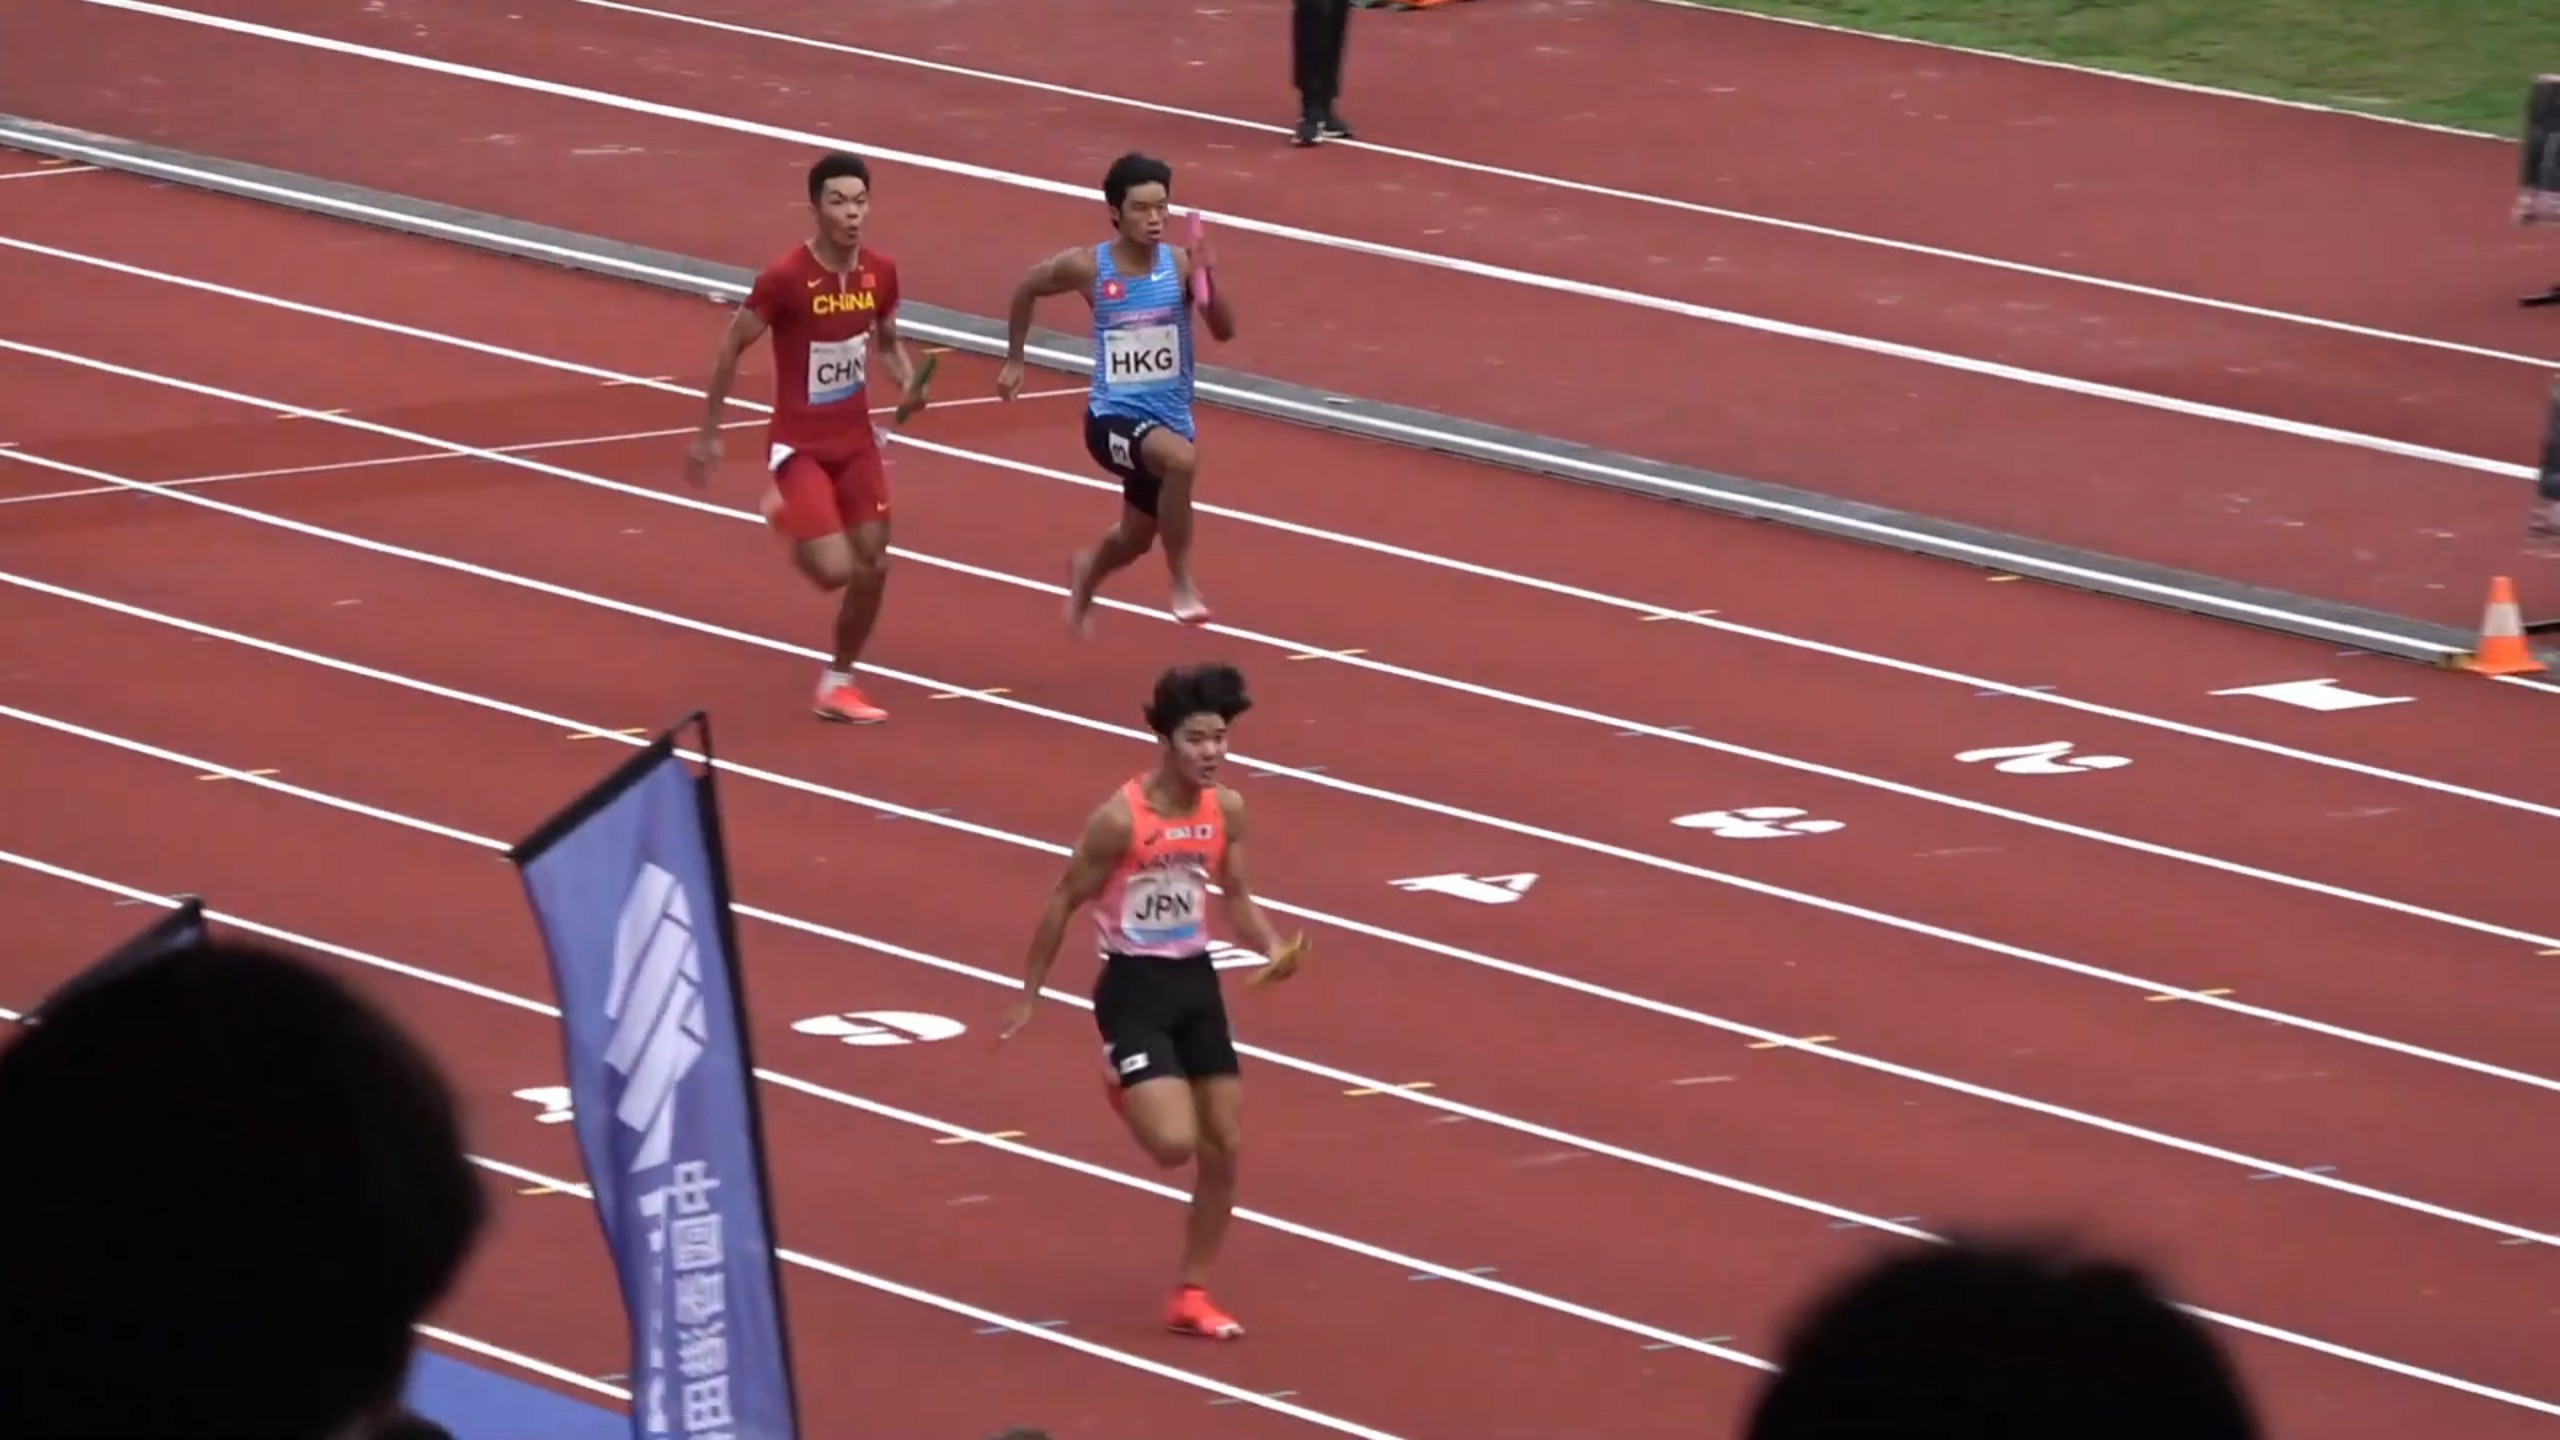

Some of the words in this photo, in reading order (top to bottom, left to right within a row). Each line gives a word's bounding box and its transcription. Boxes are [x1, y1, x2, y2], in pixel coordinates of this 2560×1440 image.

[812, 291, 875, 314] CHINA
[817, 358, 863, 385] CHN
[1111, 347, 1173, 375] HKG
[2207, 678, 2416, 711] 1
[1954, 741, 2134, 774] 2
[1671, 806, 1846, 838] 3
[1386, 872, 1540, 903] 4
[1135, 892, 1192, 921] JPN
